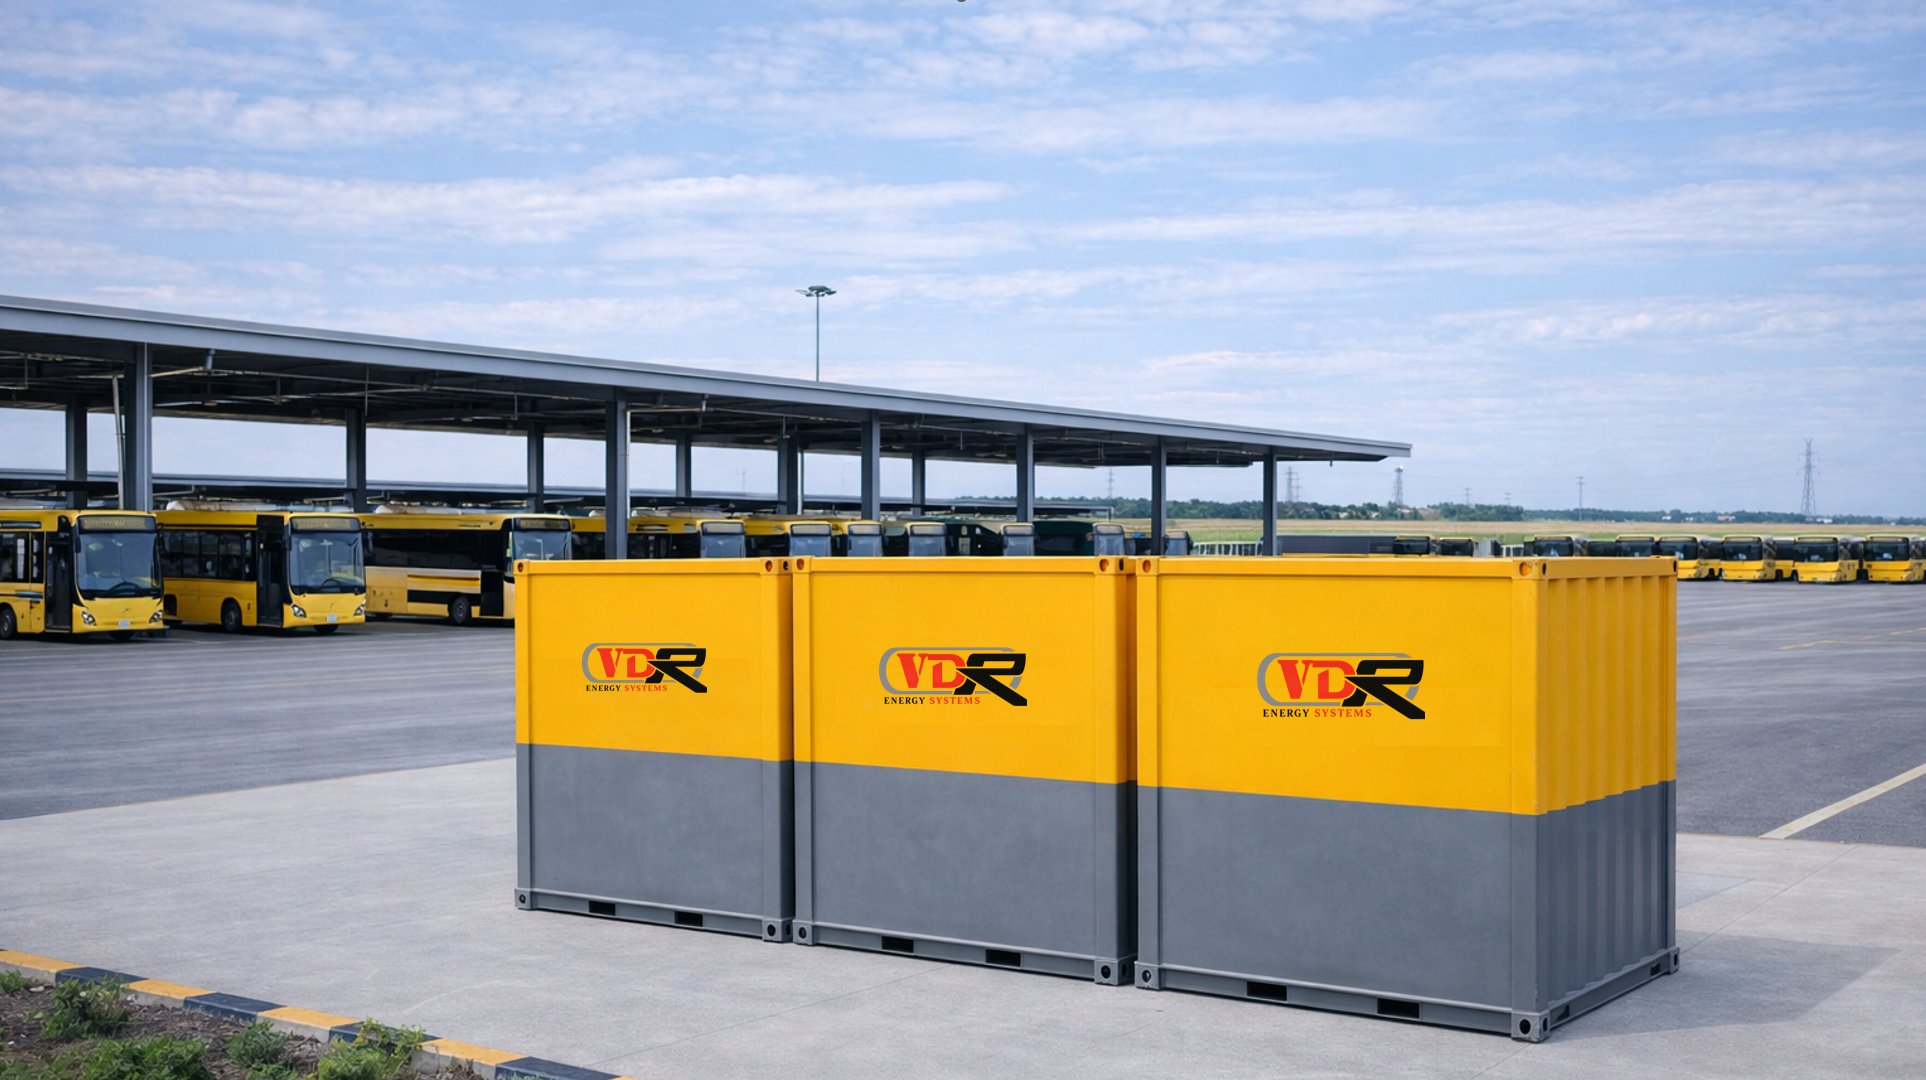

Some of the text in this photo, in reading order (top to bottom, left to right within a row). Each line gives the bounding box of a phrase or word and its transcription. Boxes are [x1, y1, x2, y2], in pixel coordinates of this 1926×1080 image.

[596, 647, 708, 694] VDR
[896, 653, 1028, 707] VDR
[586, 684, 668, 692] ENERGY SYSTEMS
[884, 695, 981, 705] ENERGY SYSTEMS
[1277, 659, 1426, 720] VDR
[1263, 708, 1372, 718] ENERGY SYSTEMS
